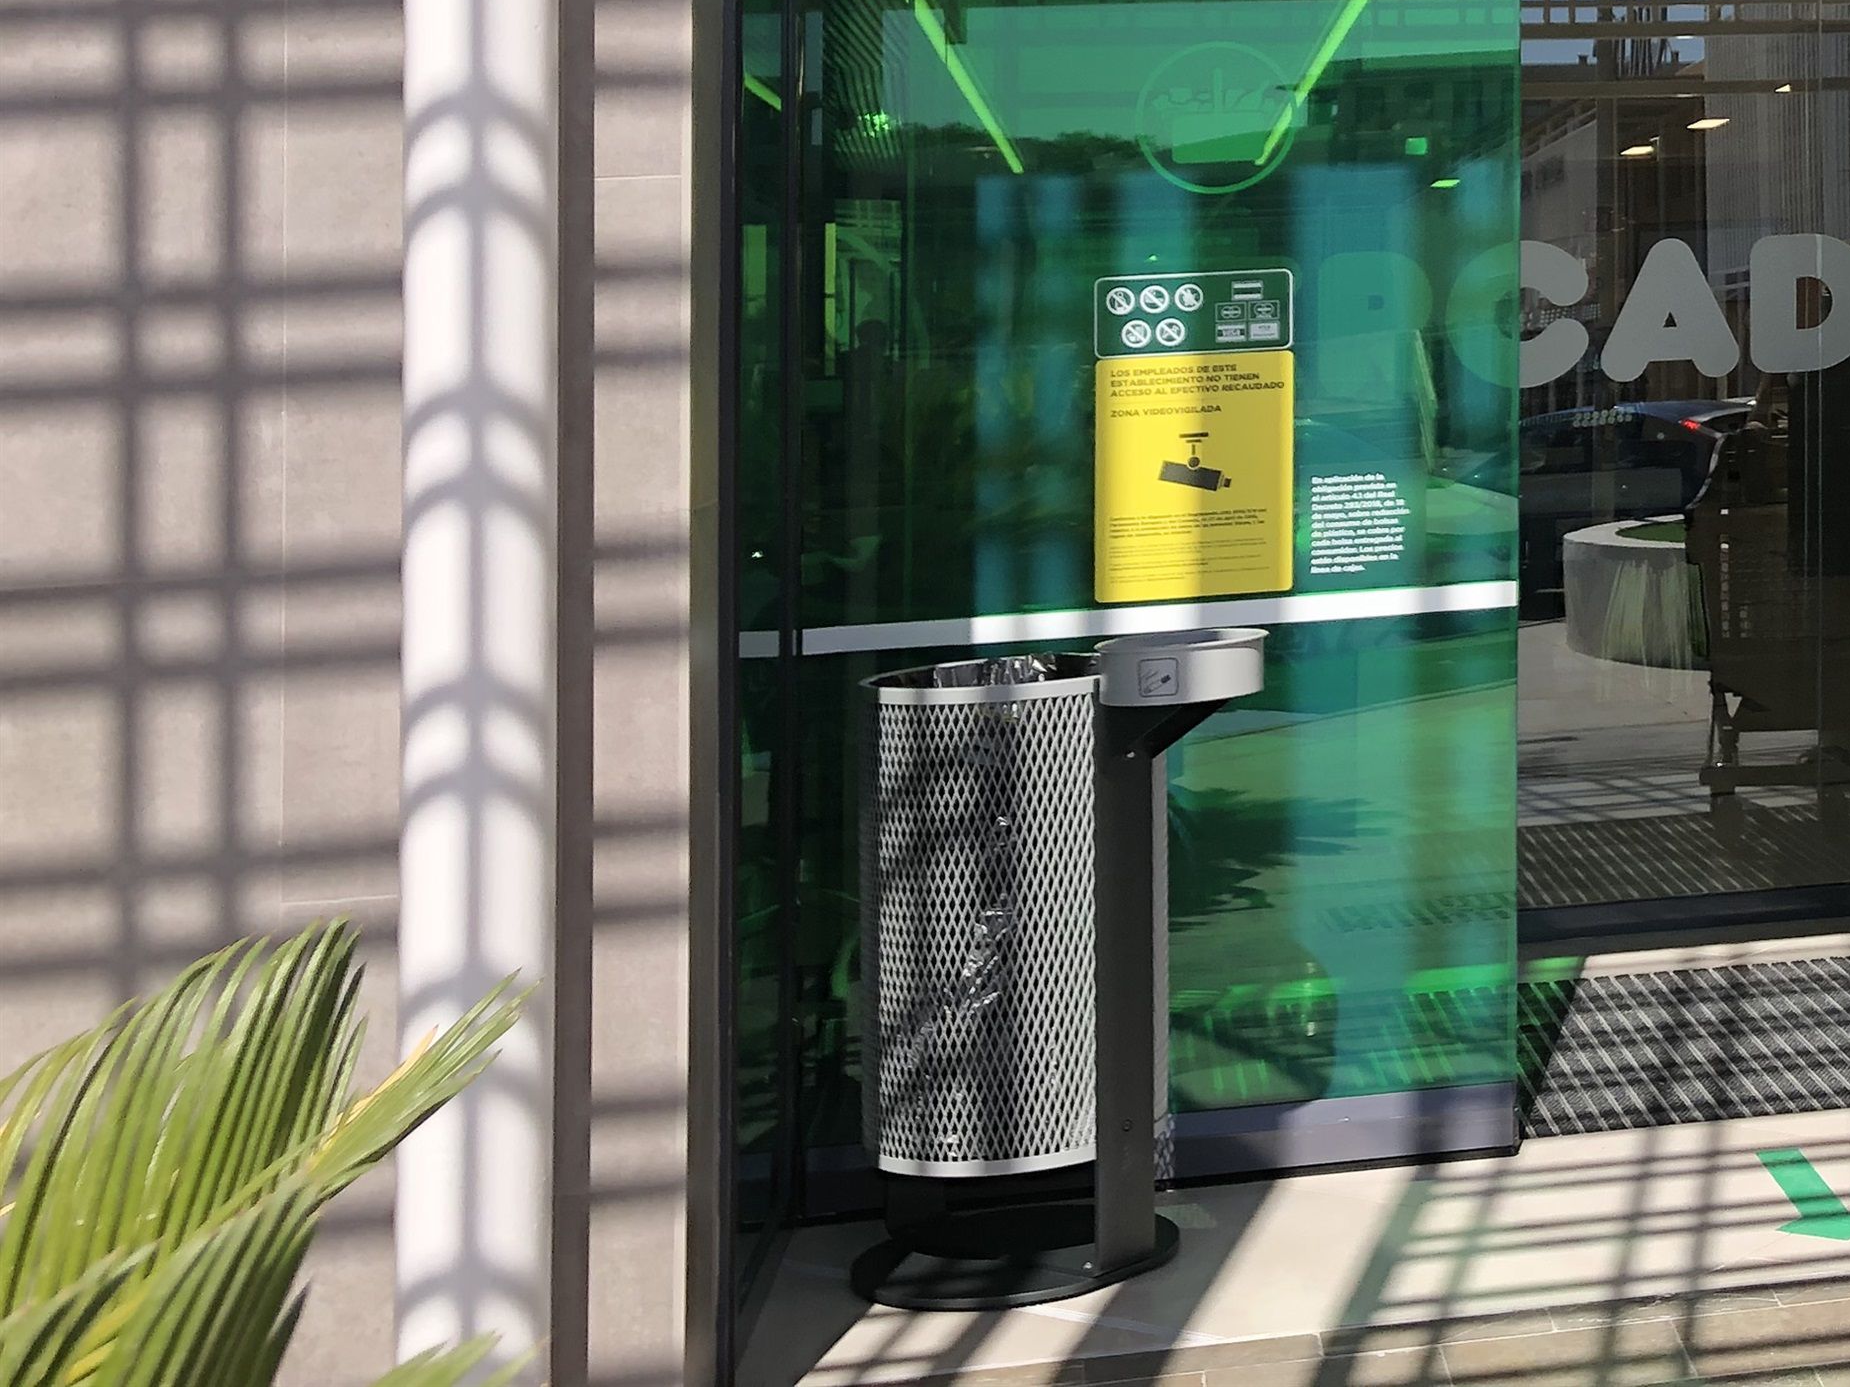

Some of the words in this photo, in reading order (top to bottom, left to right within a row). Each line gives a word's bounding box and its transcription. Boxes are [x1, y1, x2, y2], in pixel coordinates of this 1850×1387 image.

[1110, 369, 1130, 378] LOS
[1133, 366, 1194, 376] EMPLEADOS
[1196, 365, 1210, 373] DE
[1212, 364, 1238, 372] ESTE
[1110, 376, 1204, 388] ESTABLECIMIENTO
[1206, 374, 1222, 382] NO
[1224, 372, 1260, 382] TIENEN
[1110, 388, 1152, 398] ACCESO
[1154, 387, 1168, 395] AL
[1170, 384, 1220, 394] EFECTIVO
[1222, 381, 1285, 392] RECAUDADO
[1110, 409, 1140, 418] ZONA
[1142, 404, 1222, 416] VIDEOVIGILADA
